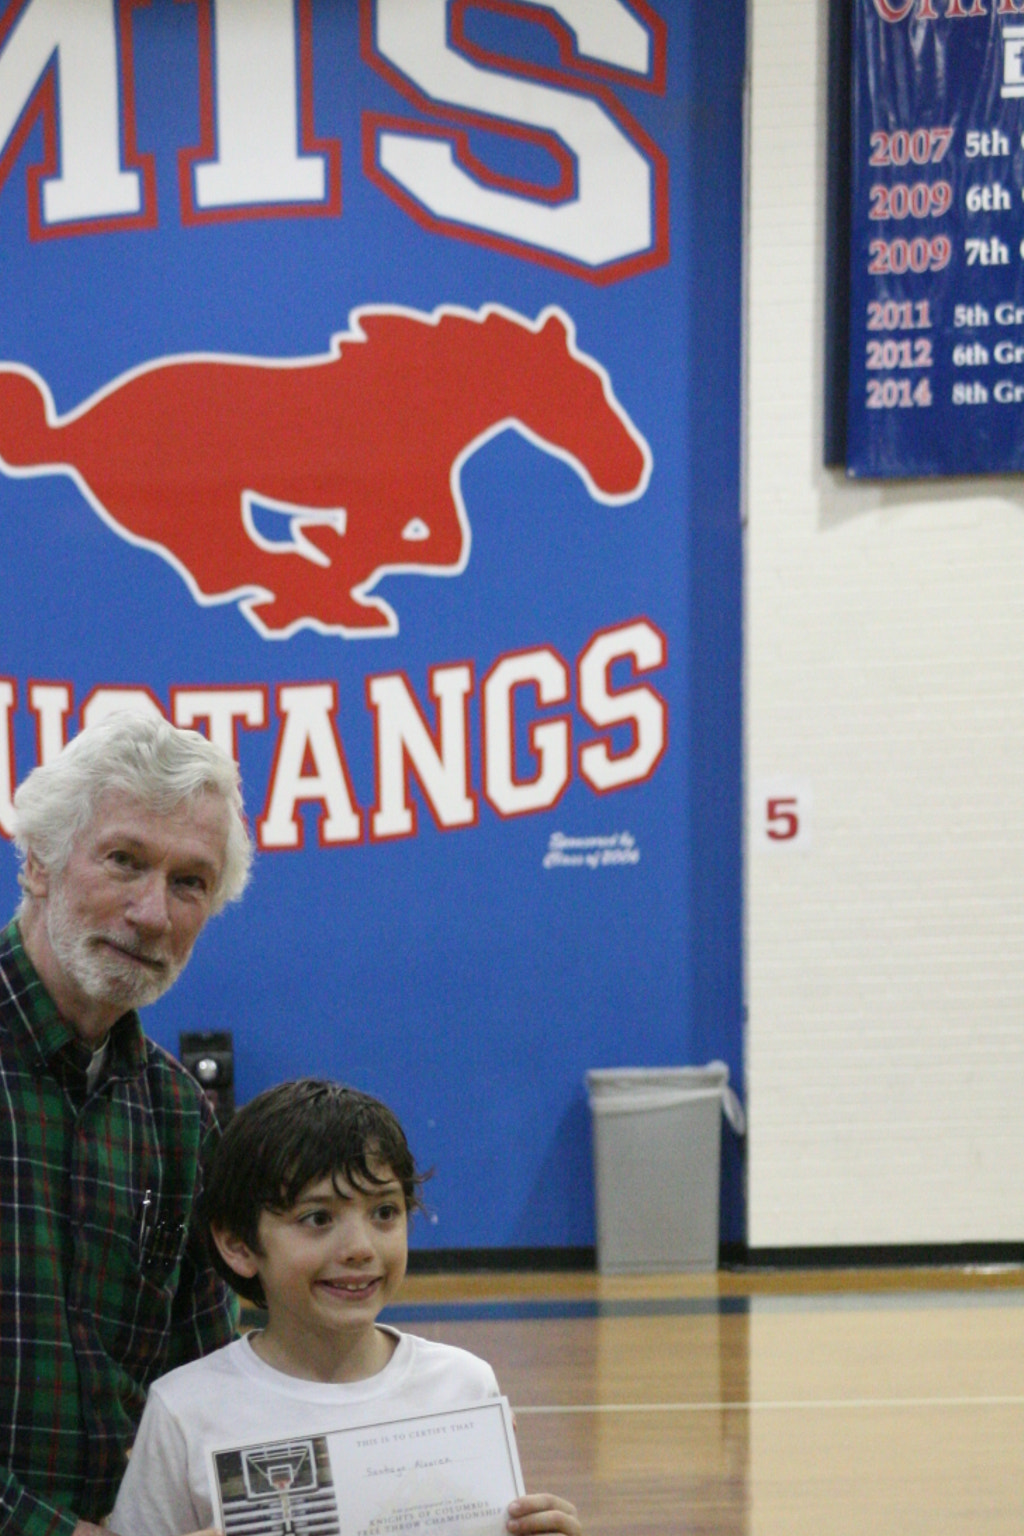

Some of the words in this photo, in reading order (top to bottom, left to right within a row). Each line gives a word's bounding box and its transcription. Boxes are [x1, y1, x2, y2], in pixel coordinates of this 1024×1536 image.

[868, 127, 954, 166] 2007
[964, 129, 1010, 157] 5th
[868, 181, 952, 220] 2009
[965, 182, 1011, 212] 6th
[867, 234, 951, 275] 2009
[964, 236, 1009, 266] 7th
[866, 299, 932, 331] 2011
[954, 304, 990, 328] 5th
[865, 338, 933, 370] 2012
[952, 342, 989, 367] 6th
[865, 376, 932, 409] 2014
[766, 798, 798, 841] 5
